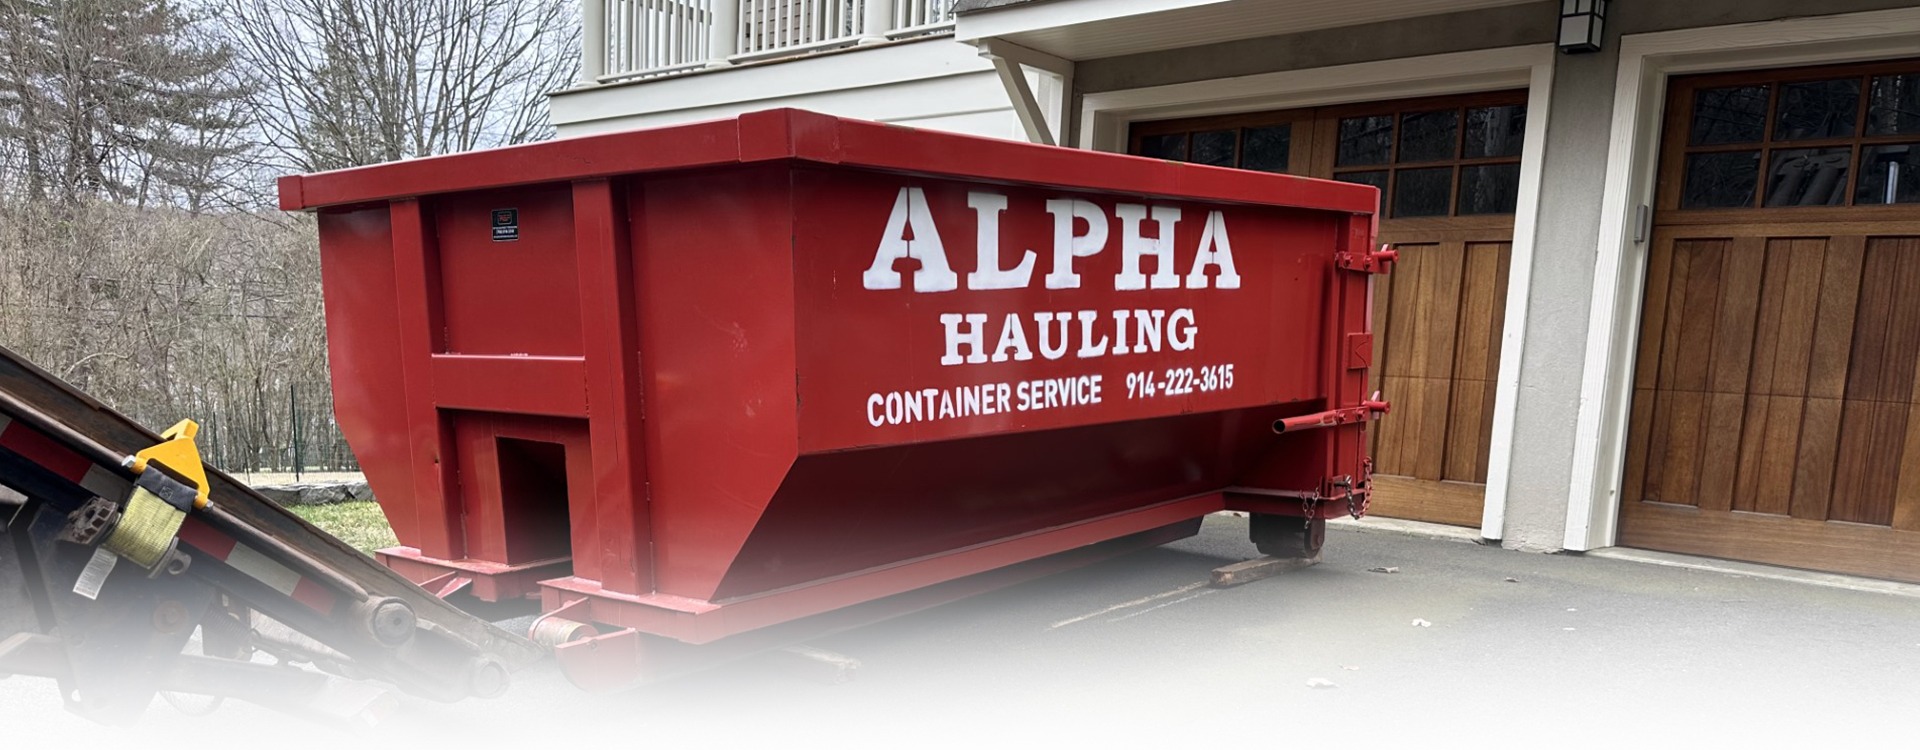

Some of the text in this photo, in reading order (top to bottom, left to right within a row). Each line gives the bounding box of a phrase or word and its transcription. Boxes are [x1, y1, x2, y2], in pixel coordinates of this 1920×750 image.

[862, 186, 1241, 293] ALPHA
[939, 308, 1198, 366] HAULING
[866, 363, 1234, 428] CONTAINER SERVICE 914-222-3615
